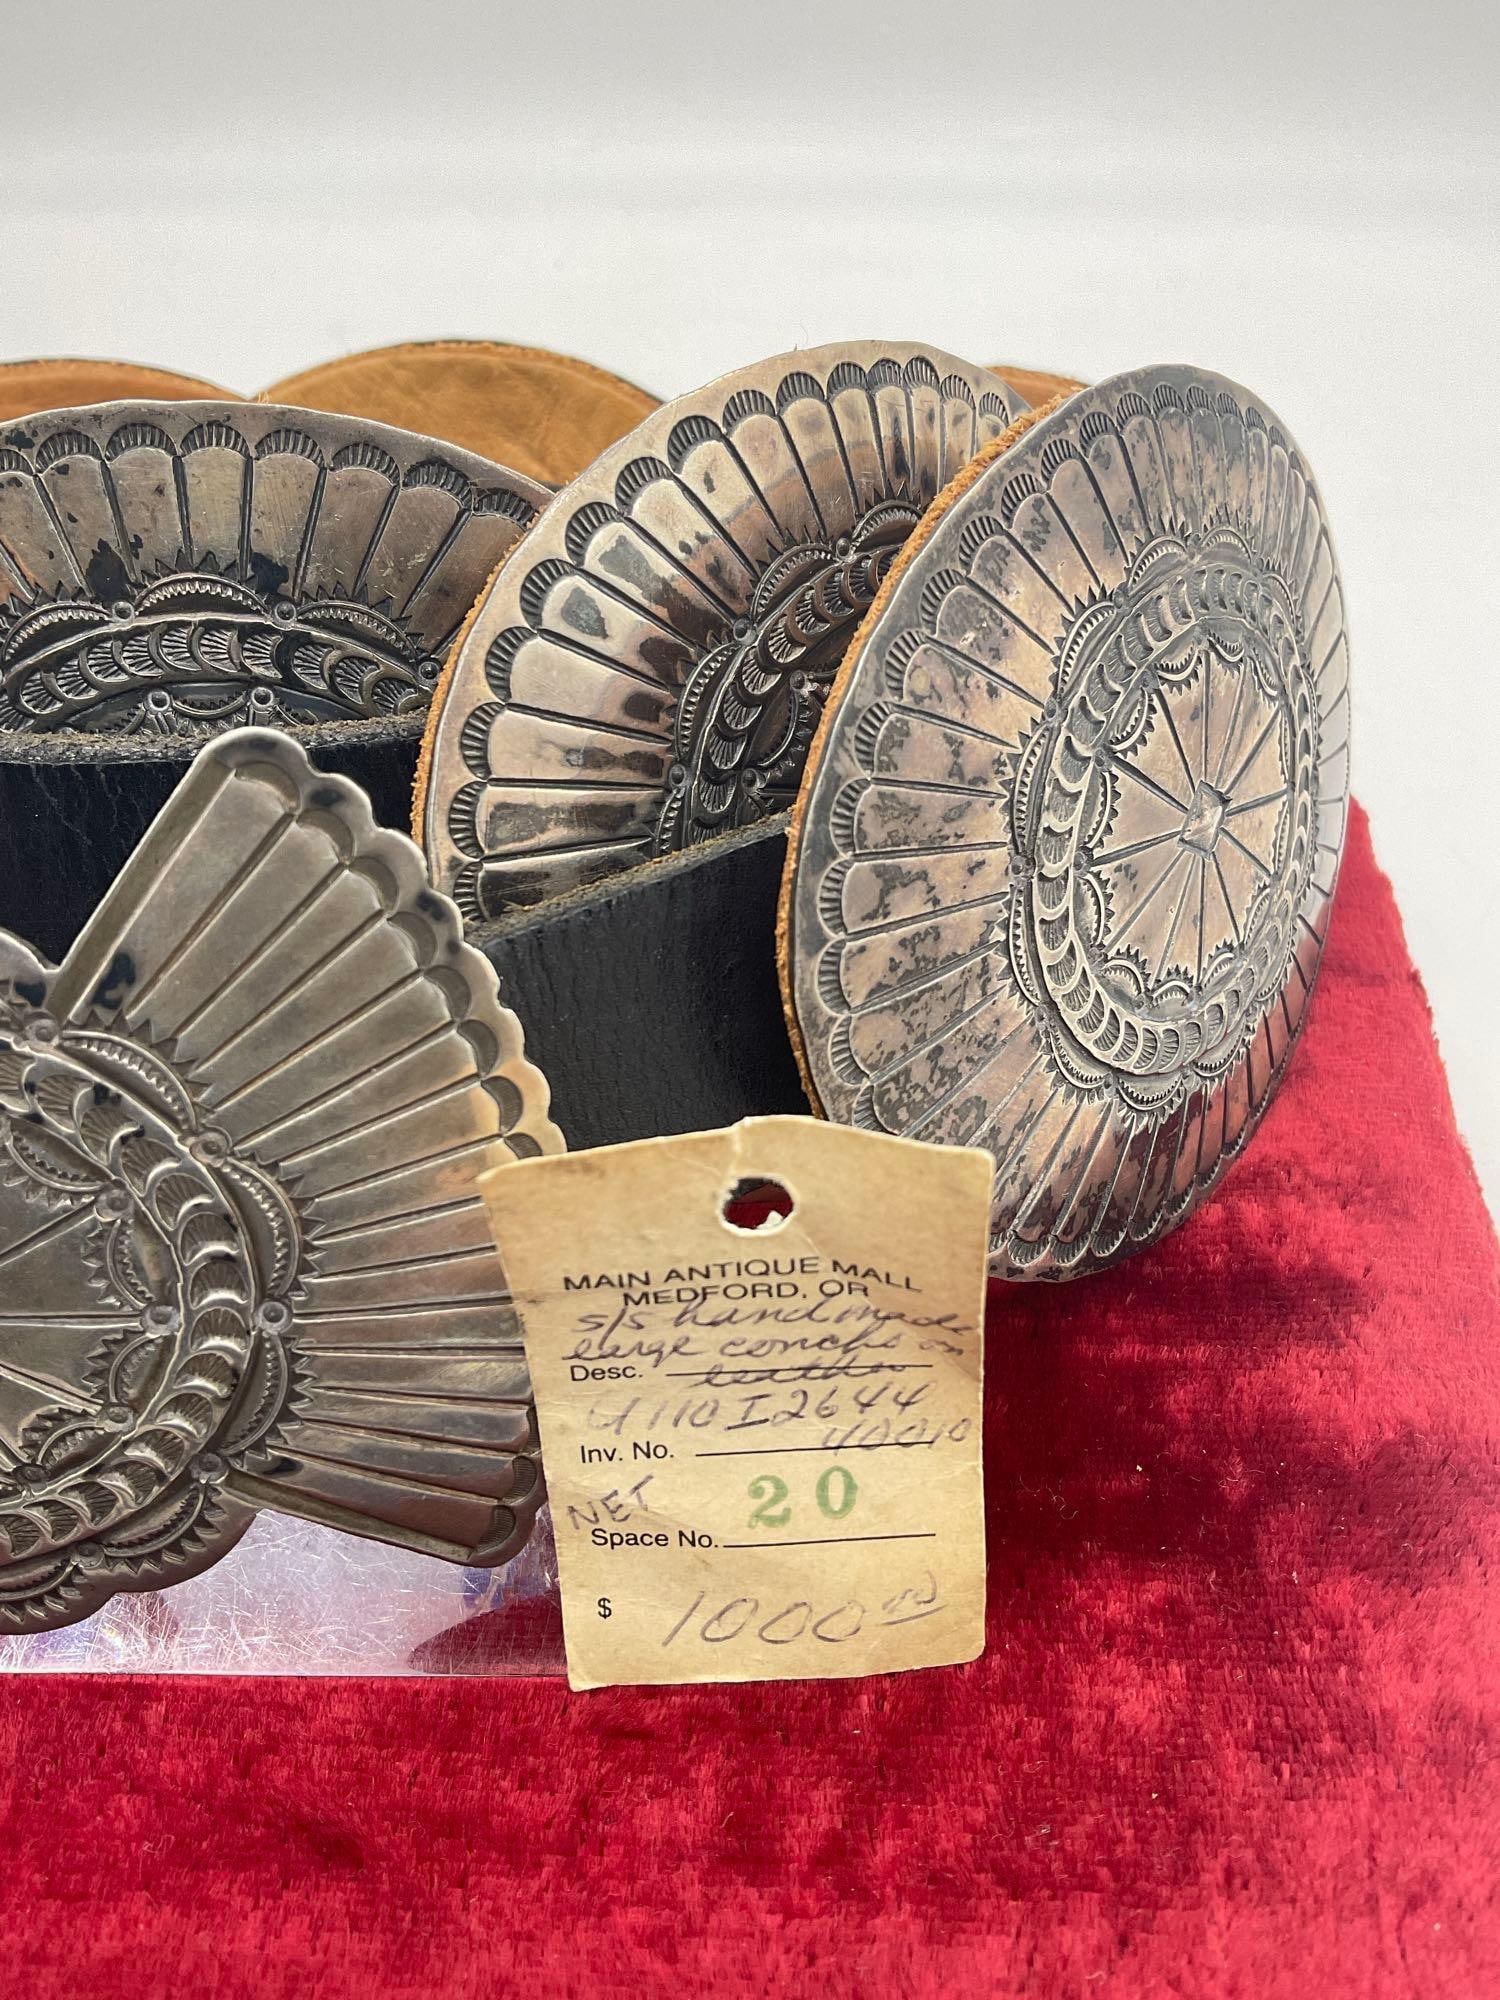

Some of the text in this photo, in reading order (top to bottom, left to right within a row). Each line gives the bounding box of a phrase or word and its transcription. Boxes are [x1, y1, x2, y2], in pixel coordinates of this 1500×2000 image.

[563, 1256, 922, 1293] MAIN ANTIQUE MALL
[819, 1279, 869, 1297] OR
[570, 1364, 643, 1382] Desc.
[581, 1441, 675, 1464] Inv. No.
[567, 1474, 654, 1530] NET
[591, 1528, 719, 1550] Space No.
[597, 1597, 613, 1619] $
